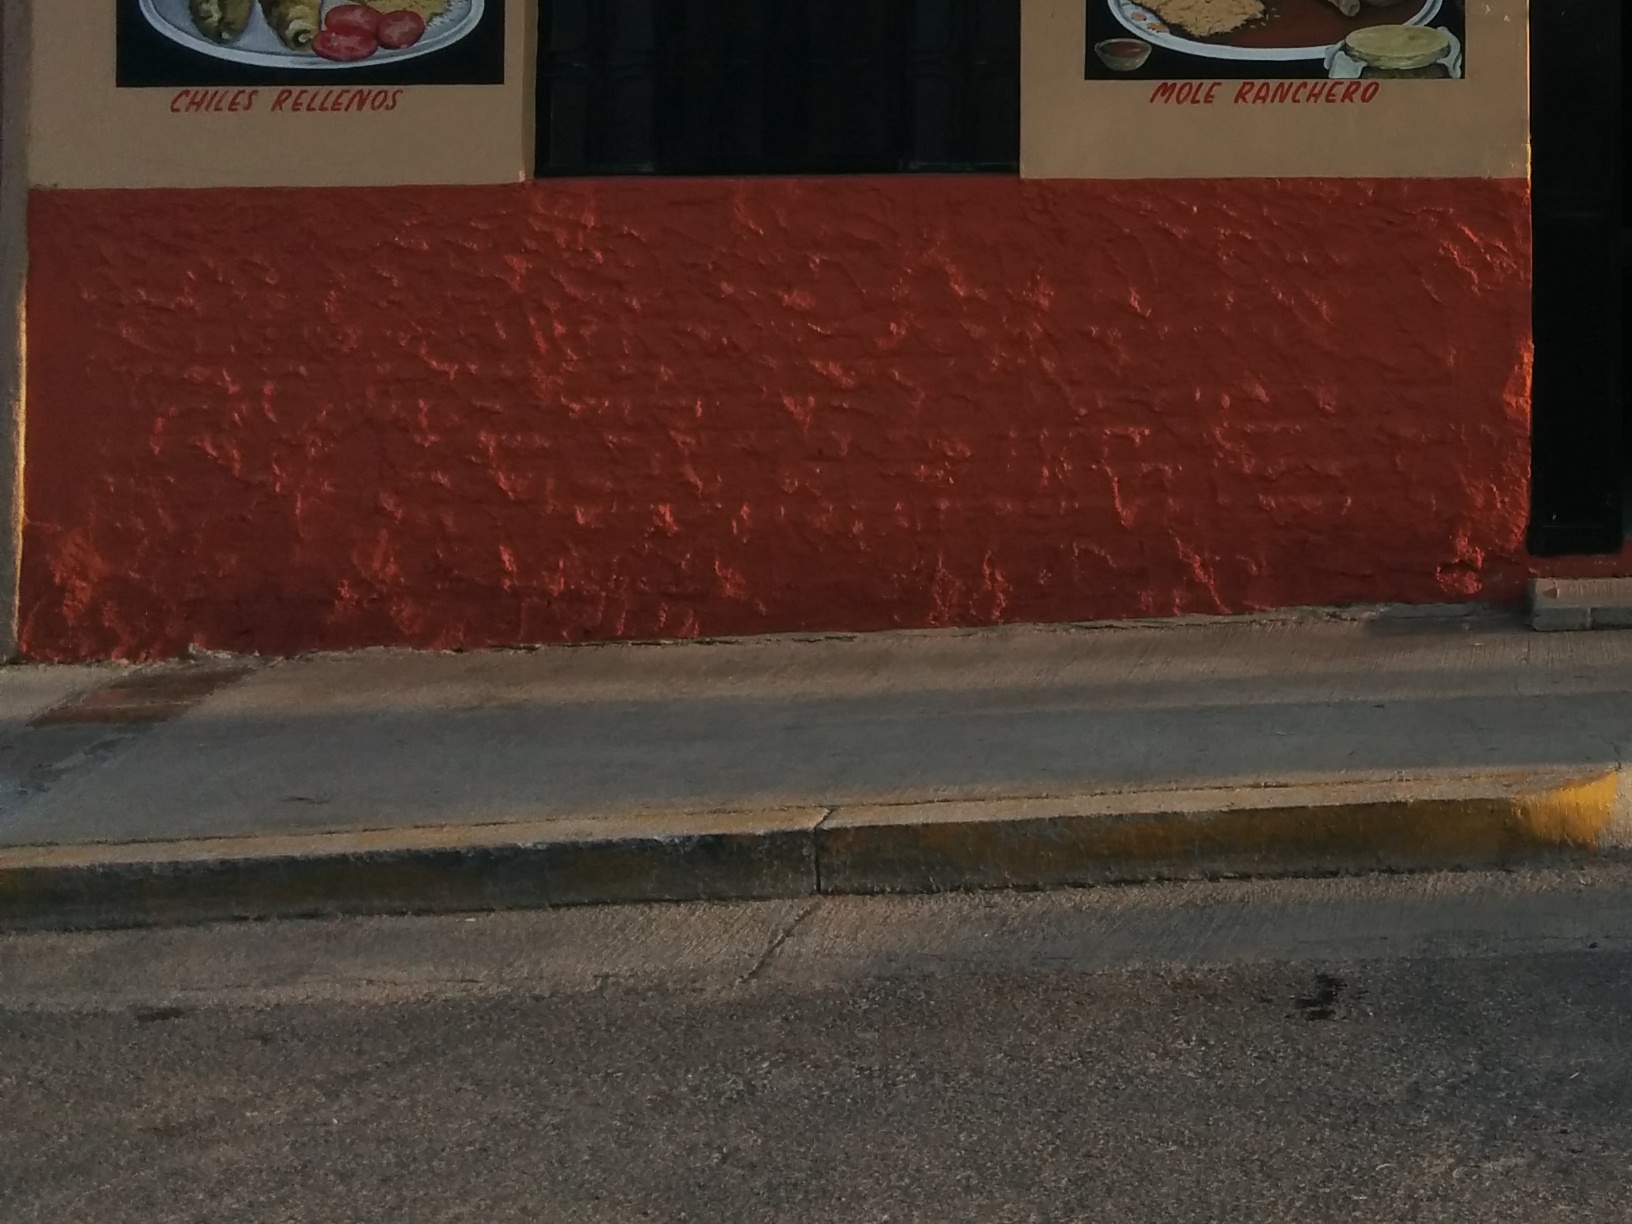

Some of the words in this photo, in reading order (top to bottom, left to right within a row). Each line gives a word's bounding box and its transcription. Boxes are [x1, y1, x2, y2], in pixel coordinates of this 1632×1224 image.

[170, 89, 259, 113] CHILES
[271, 88, 404, 113] RELLENOS
[1149, 81, 1223, 105] MOLE
[1233, 81, 1381, 105] RANCHERO
